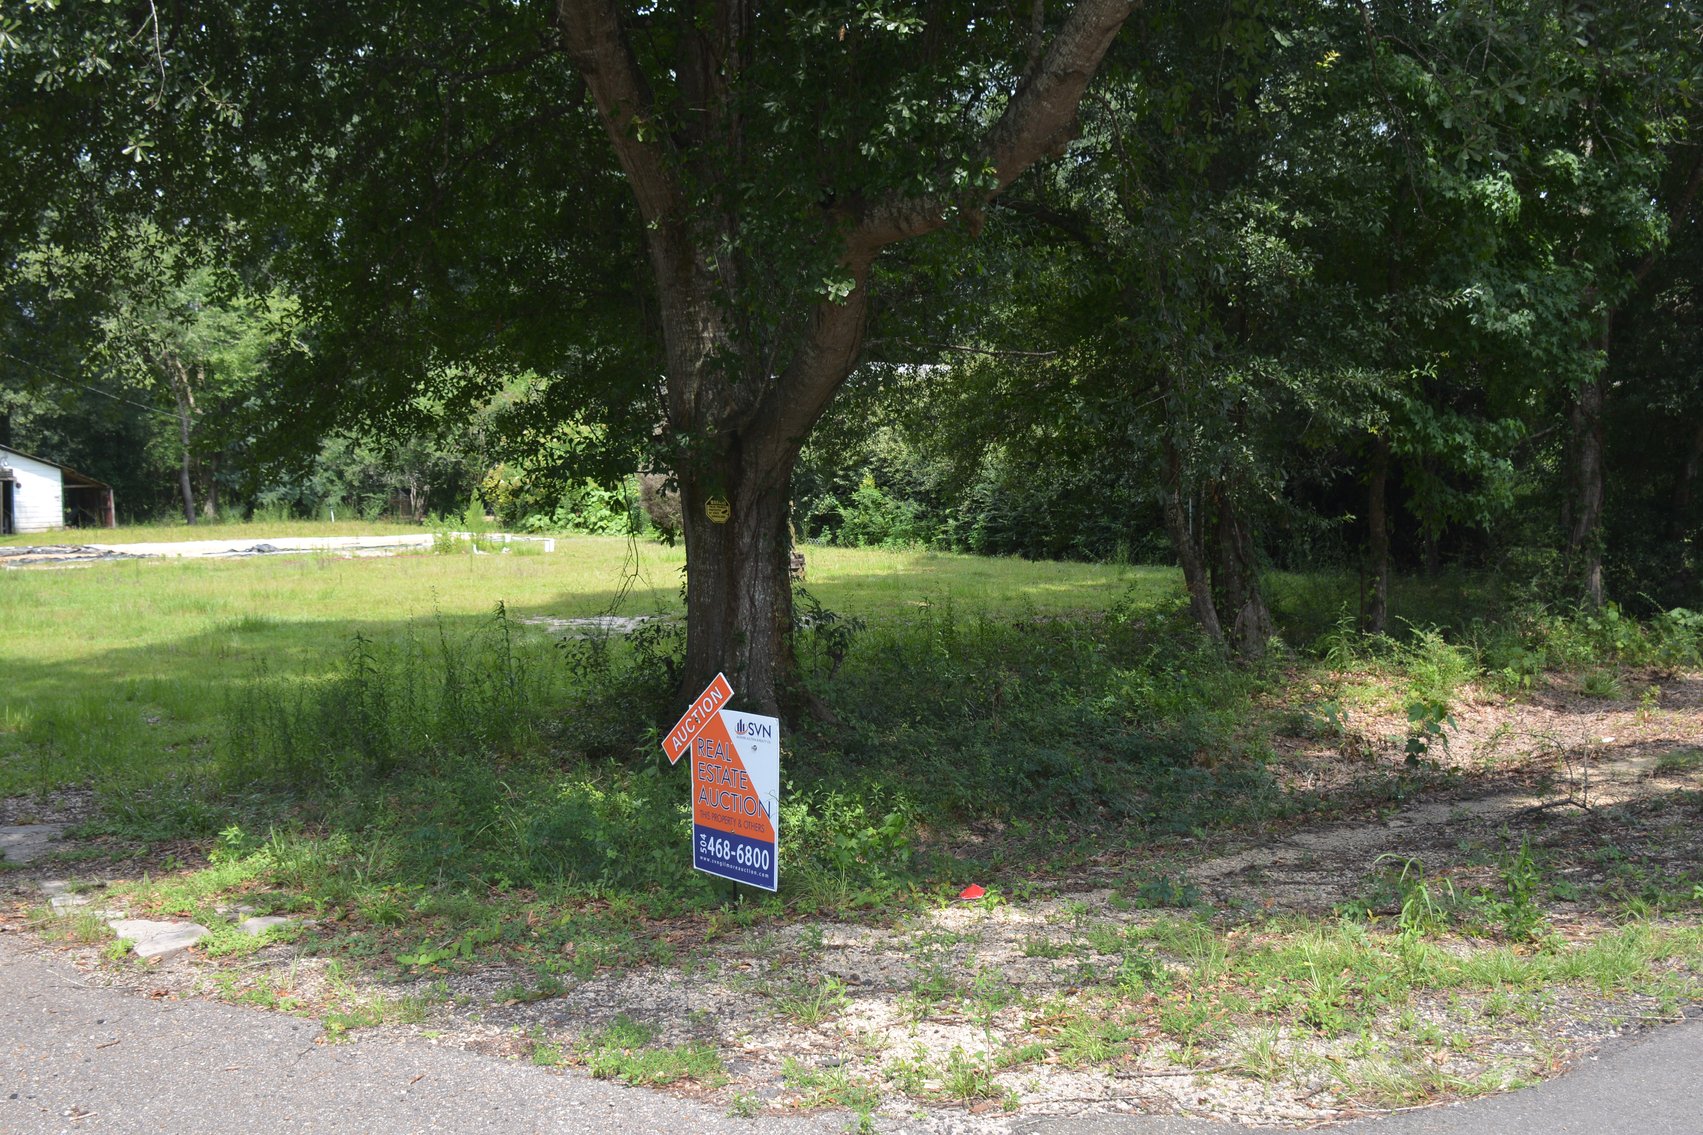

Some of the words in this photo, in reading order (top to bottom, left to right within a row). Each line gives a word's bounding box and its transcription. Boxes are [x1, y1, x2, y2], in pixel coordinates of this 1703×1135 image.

[672, 686, 723, 752] AUCTION
[748, 722, 771, 739] SVN
[698, 738, 732, 763] REAL
[698, 762, 748, 790] ESTATE
[698, 788, 771, 819] AUCTION
[700, 809, 712, 821] THIS
[711, 813, 736, 826] PROPERTY
[738, 819, 742, 828] &
[744, 820, 765, 832] OTHERS
[707, 836, 770, 871] 468-6800
[700, 856, 769, 878] www.svngilmoreauction.com
